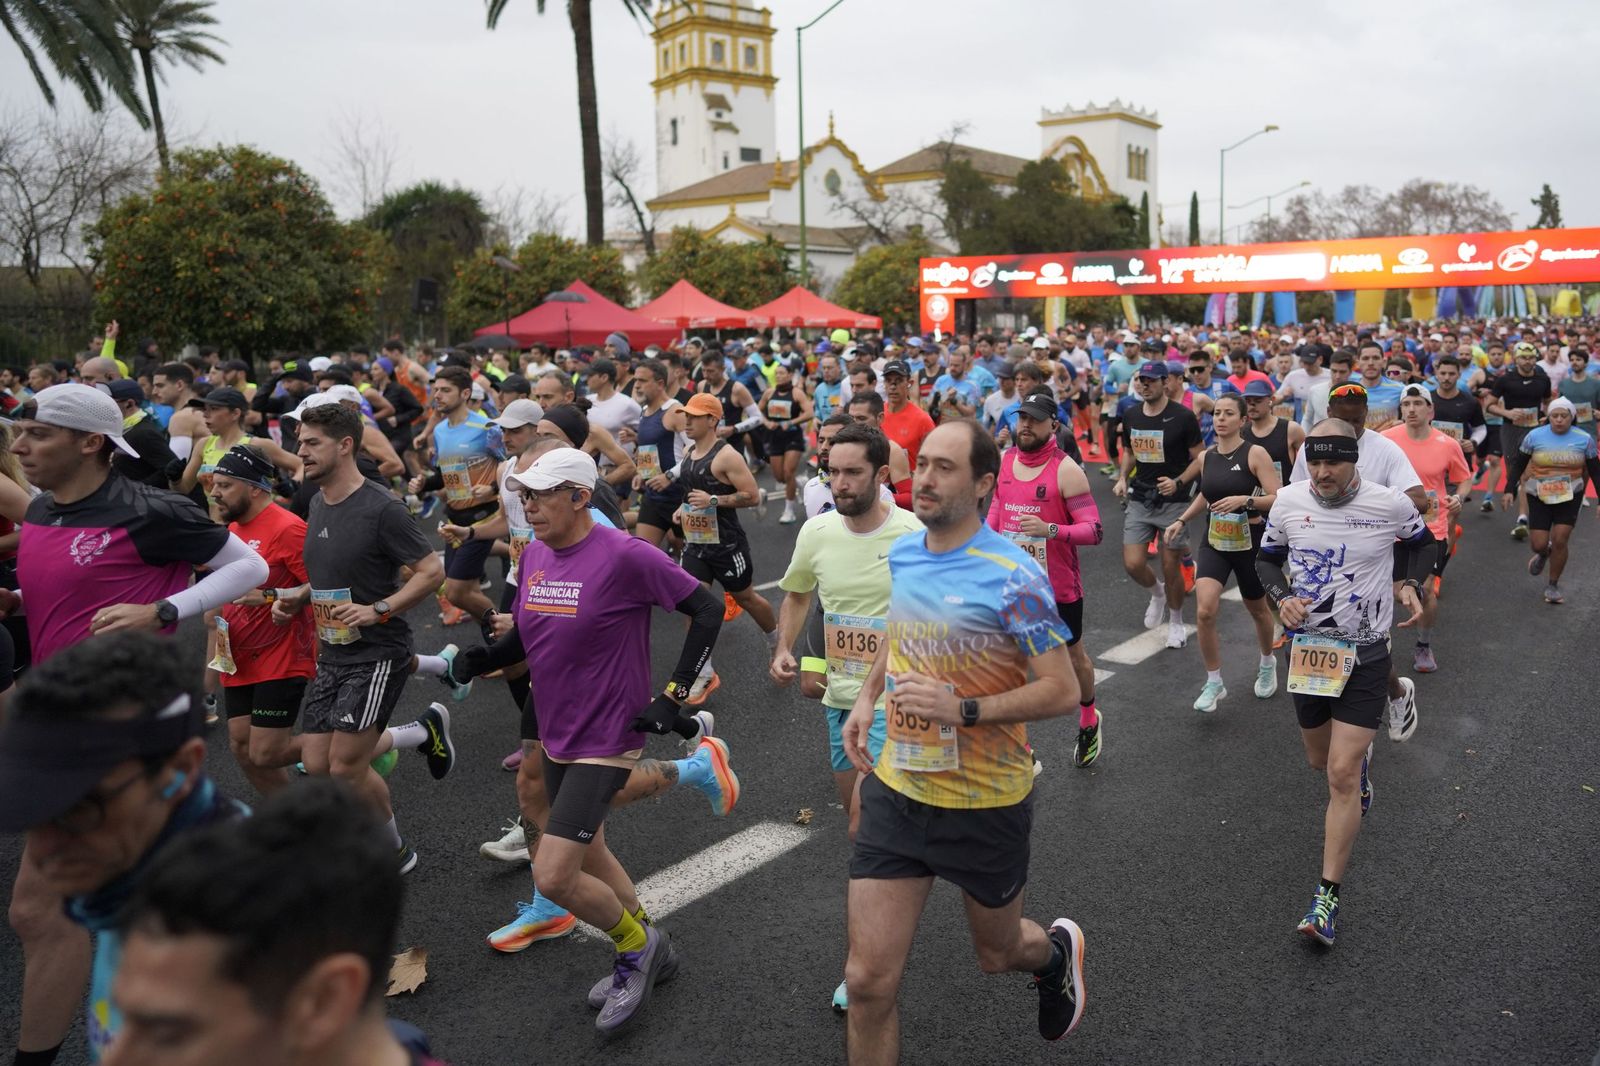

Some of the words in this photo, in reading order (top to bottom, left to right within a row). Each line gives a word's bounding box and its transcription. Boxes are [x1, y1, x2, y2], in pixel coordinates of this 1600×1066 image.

[1134, 438, 1155, 449] 5710
[1004, 503, 1041, 515] telepizza
[686, 514, 708, 528] 7855
[530, 586, 580, 598] DENUNCIAR
[836, 630, 878, 654] 8136
[1300, 648, 1339, 669] 7079
